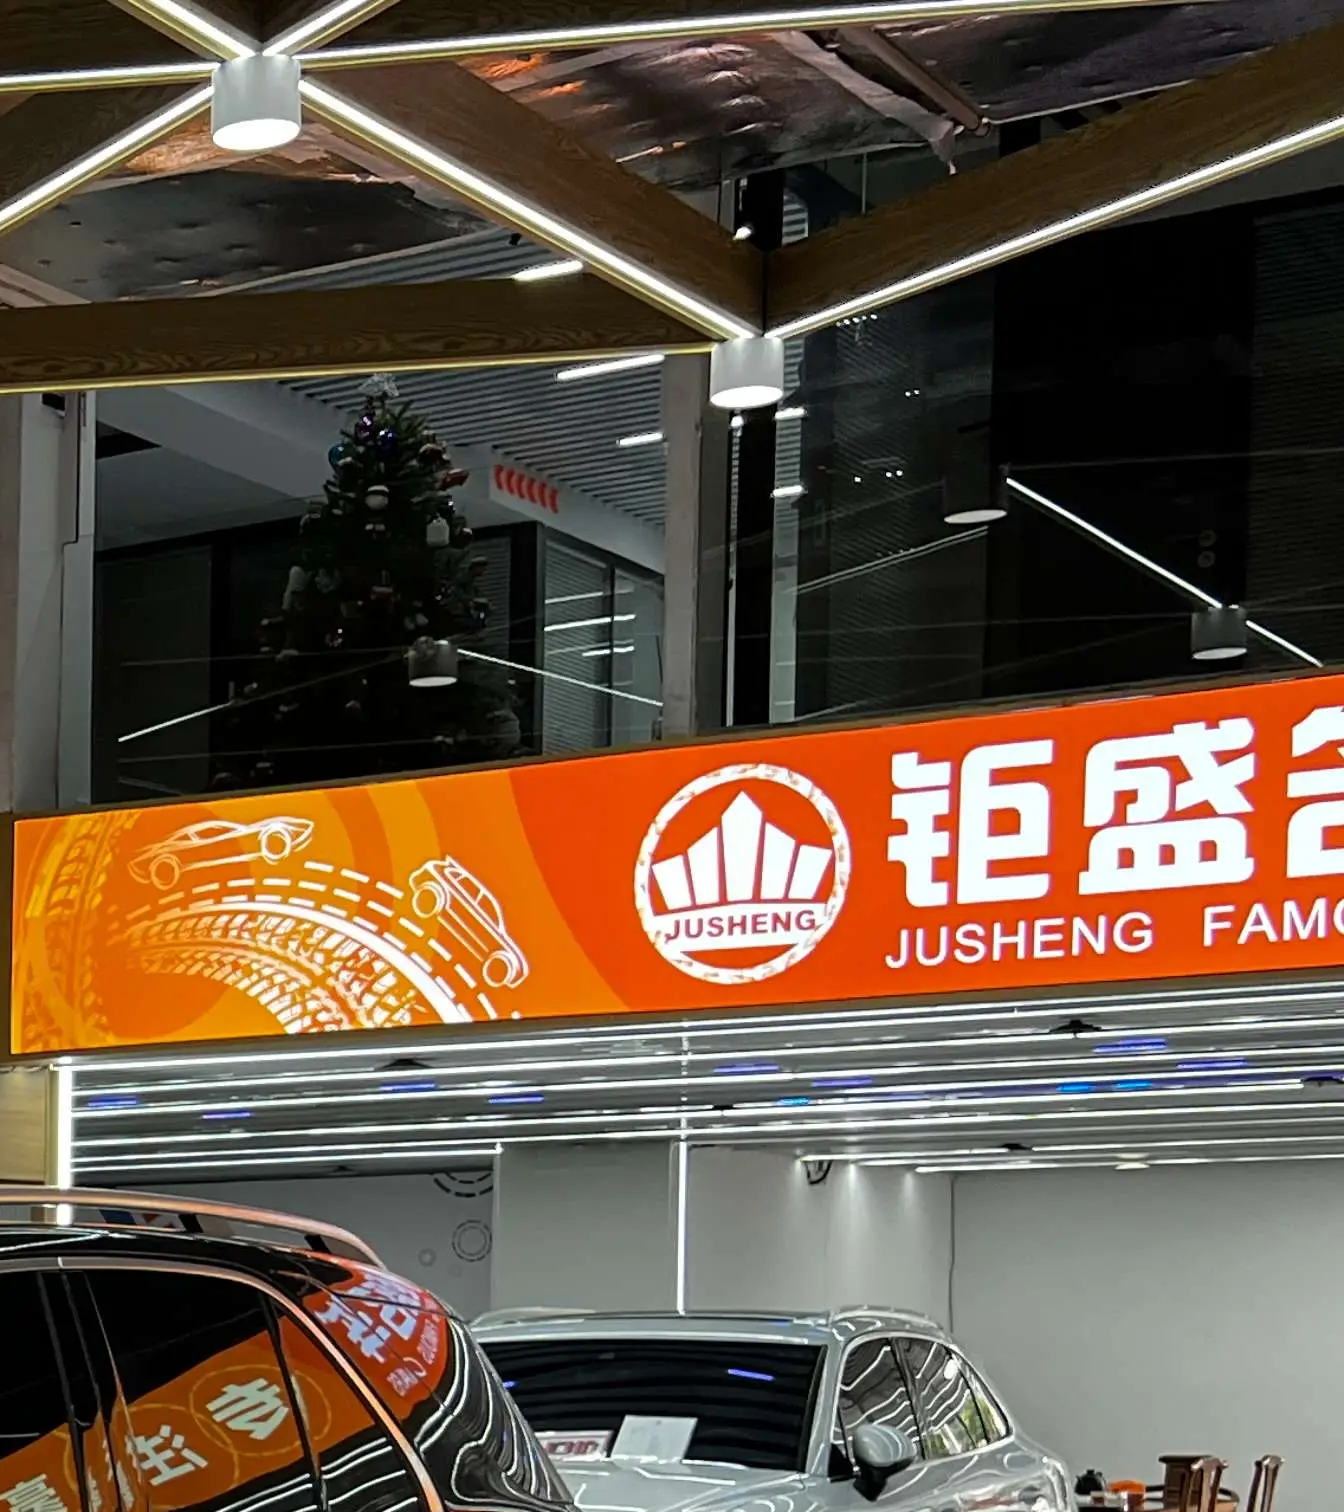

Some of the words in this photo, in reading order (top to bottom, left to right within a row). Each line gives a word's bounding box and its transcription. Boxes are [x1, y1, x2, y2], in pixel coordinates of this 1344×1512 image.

[667, 909, 817, 942] JUSHENG
[885, 910, 1156, 970] JUSHENG
[1203, 896, 1344, 948] FAM
